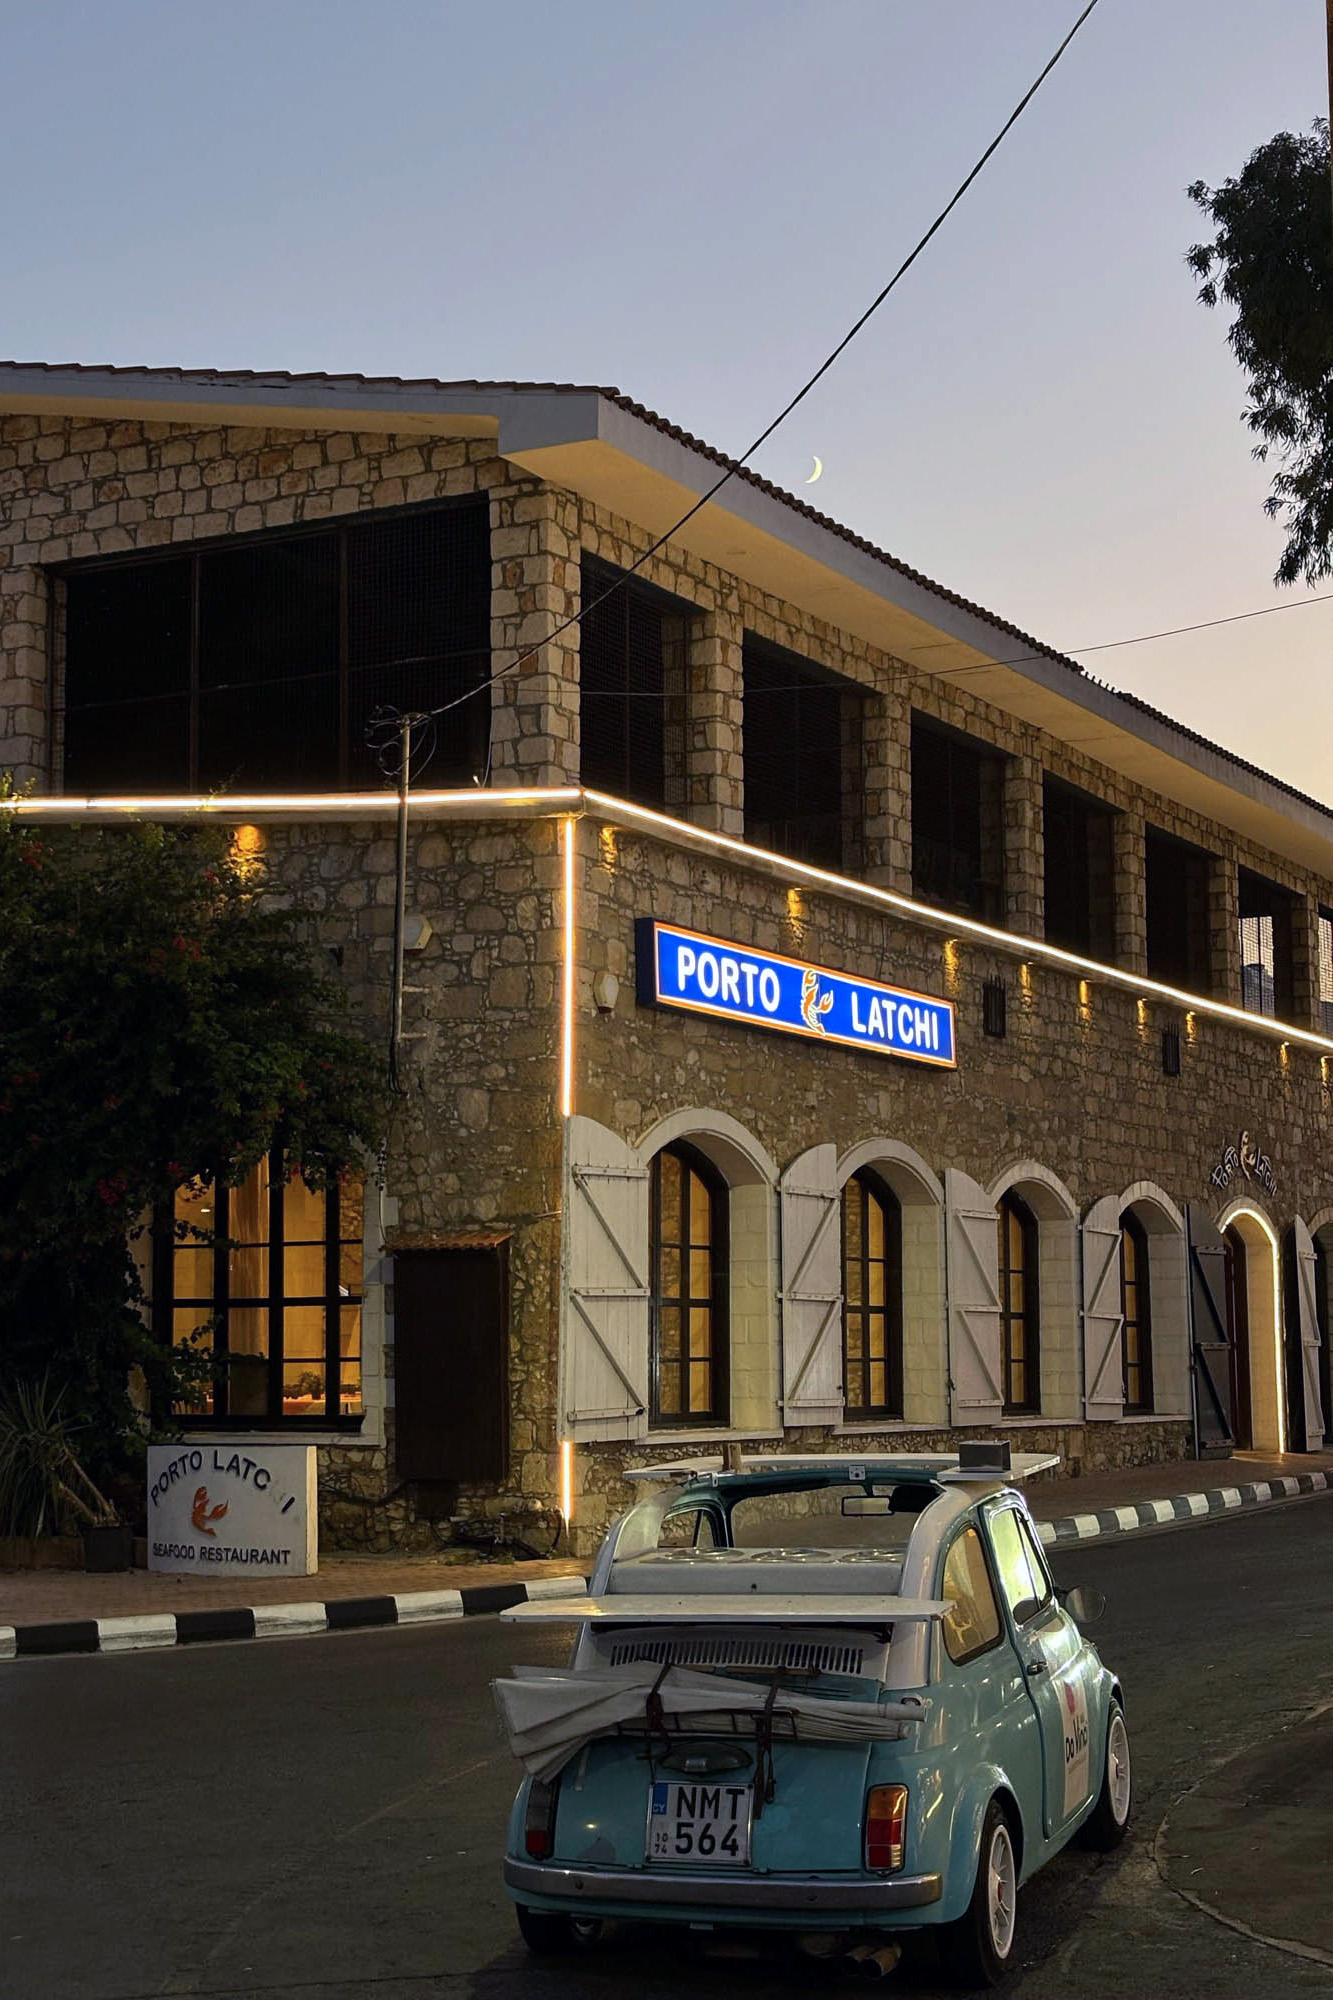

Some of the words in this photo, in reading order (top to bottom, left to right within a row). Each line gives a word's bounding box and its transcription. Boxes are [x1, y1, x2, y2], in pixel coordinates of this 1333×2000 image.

[677, 945, 780, 1012] PORTO
[851, 991, 939, 1050] LATCHI
[1212, 1146, 1239, 1189] PORTO
[151, 1450, 203, 1507] PORTO
[152, 1542, 195, 1560] SEAFOOD
[200, 1546, 291, 1565] RESTAURANT
[653, 1803, 666, 1813] CY
[676, 1786, 745, 1820] NMT
[655, 1844, 668, 1854] 74
[656, 1832, 669, 1842] 10
[675, 1822, 739, 1857] 564
